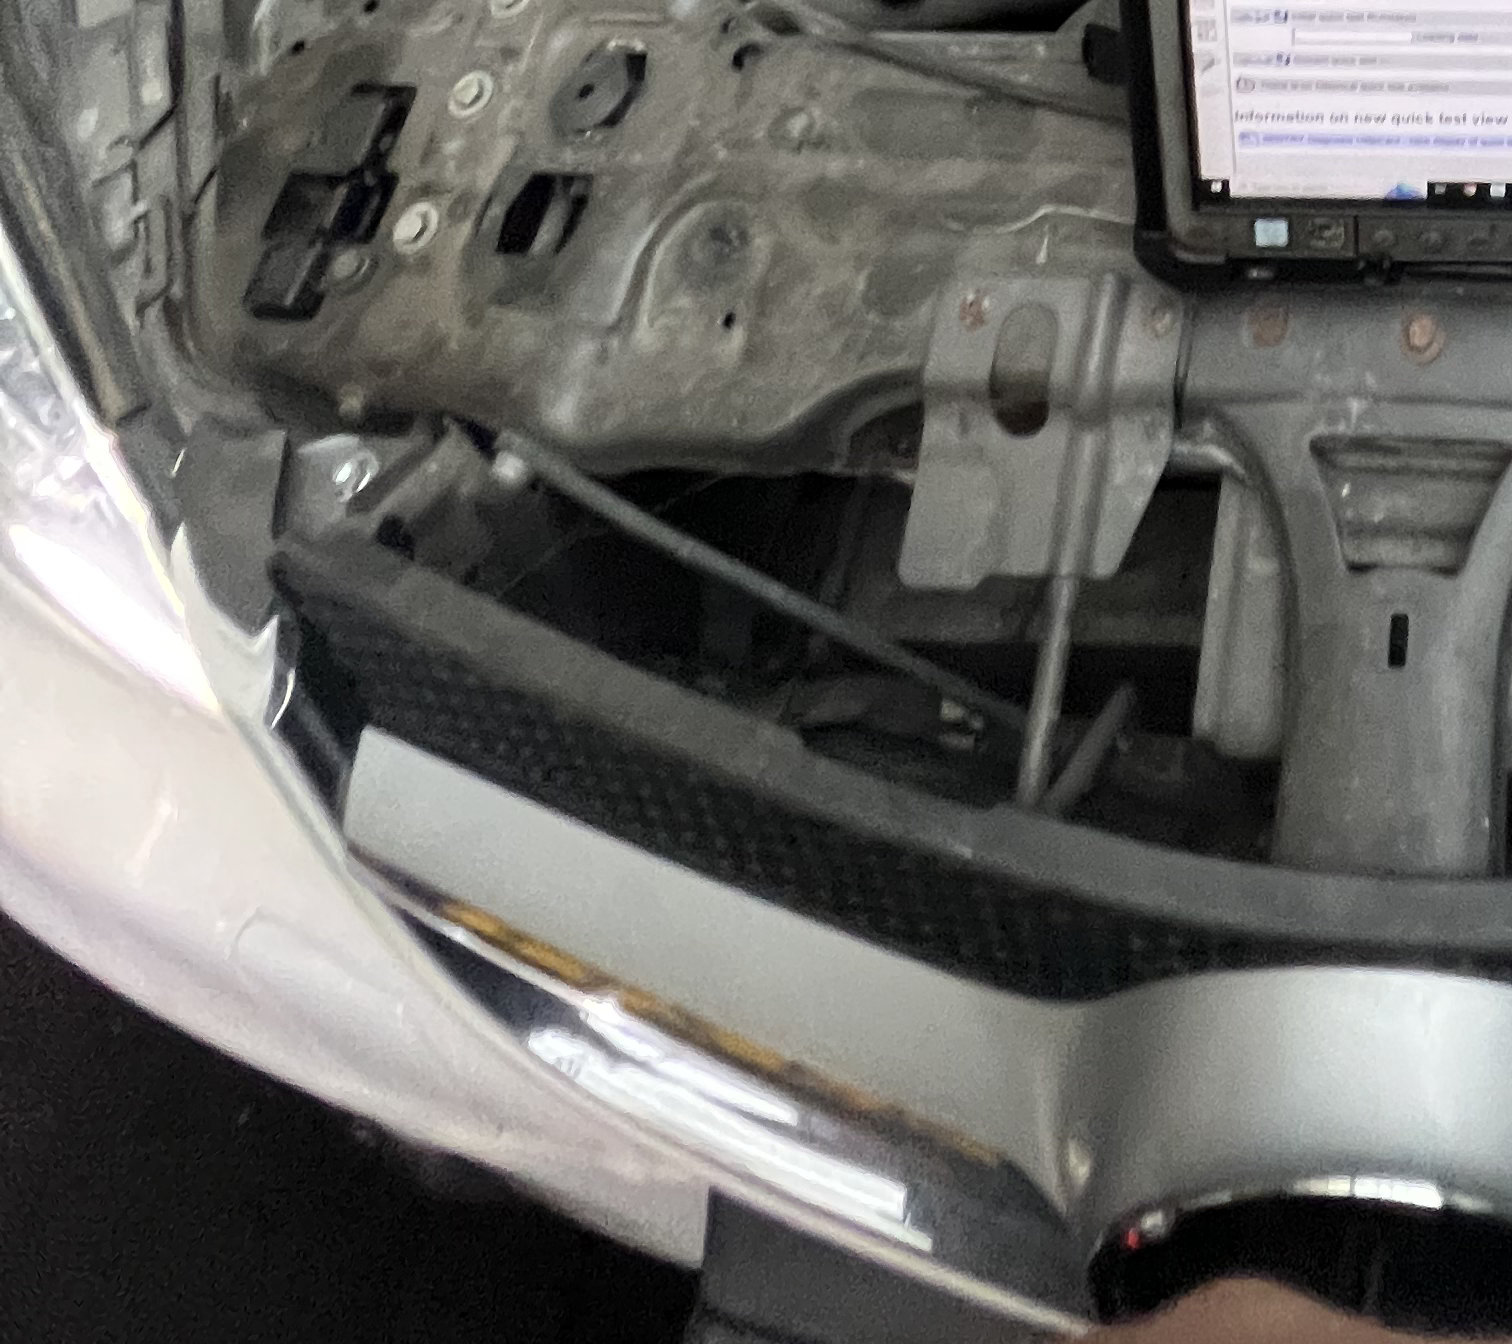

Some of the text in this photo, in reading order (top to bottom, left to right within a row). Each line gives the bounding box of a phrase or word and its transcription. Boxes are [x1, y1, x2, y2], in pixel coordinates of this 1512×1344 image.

[1234, 109, 1509, 127] Information on new quick test view
